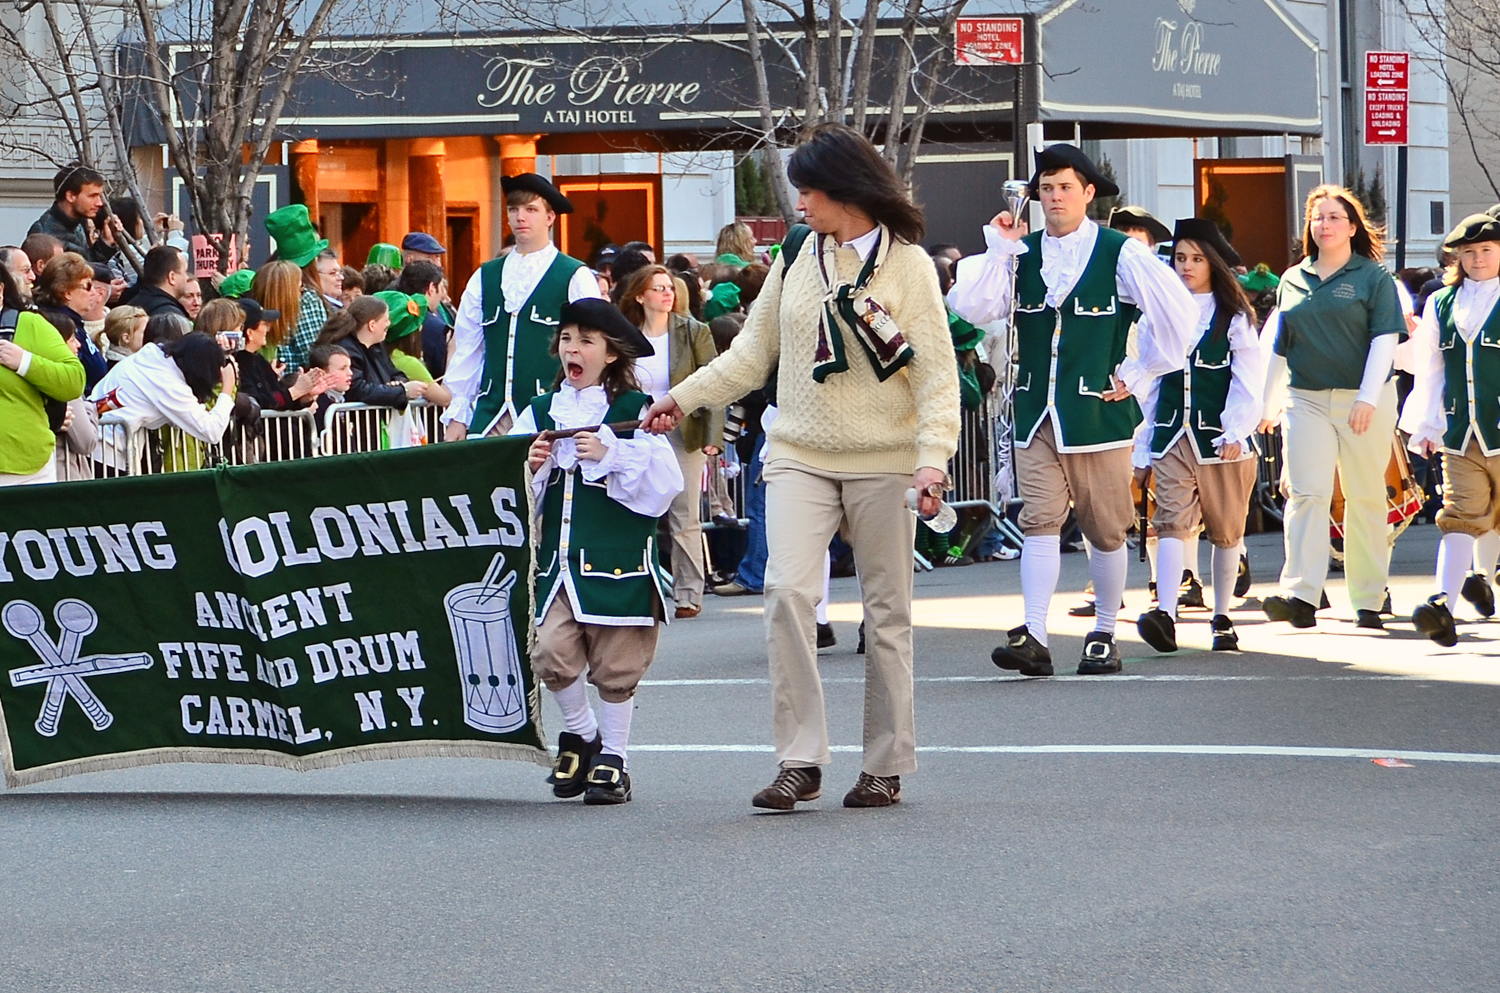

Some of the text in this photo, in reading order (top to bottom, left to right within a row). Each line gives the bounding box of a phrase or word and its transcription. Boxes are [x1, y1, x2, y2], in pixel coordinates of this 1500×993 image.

[960, 23, 1018, 33] NO STANDING
[976, 33, 1001, 41] HOTEL
[994, 42, 1012, 50] ZONE
[1152, 17, 1221, 76] The Pierre
[1369, 55, 1406, 64] NO STANDING
[477, 55, 701, 108] The Pierre
[1367, 93, 1406, 102] NO STANDING
[544, 110, 636, 126] A TAJ HOTEL
[1371, 120, 1401, 128] UNLOADING
[196, 248, 232, 259] PARK
[196, 259, 234, 270] THURSY
[157, 629, 427, 688] FIFE AND DRUM
[179, 686, 439, 745] CARMEL, N.Y.
